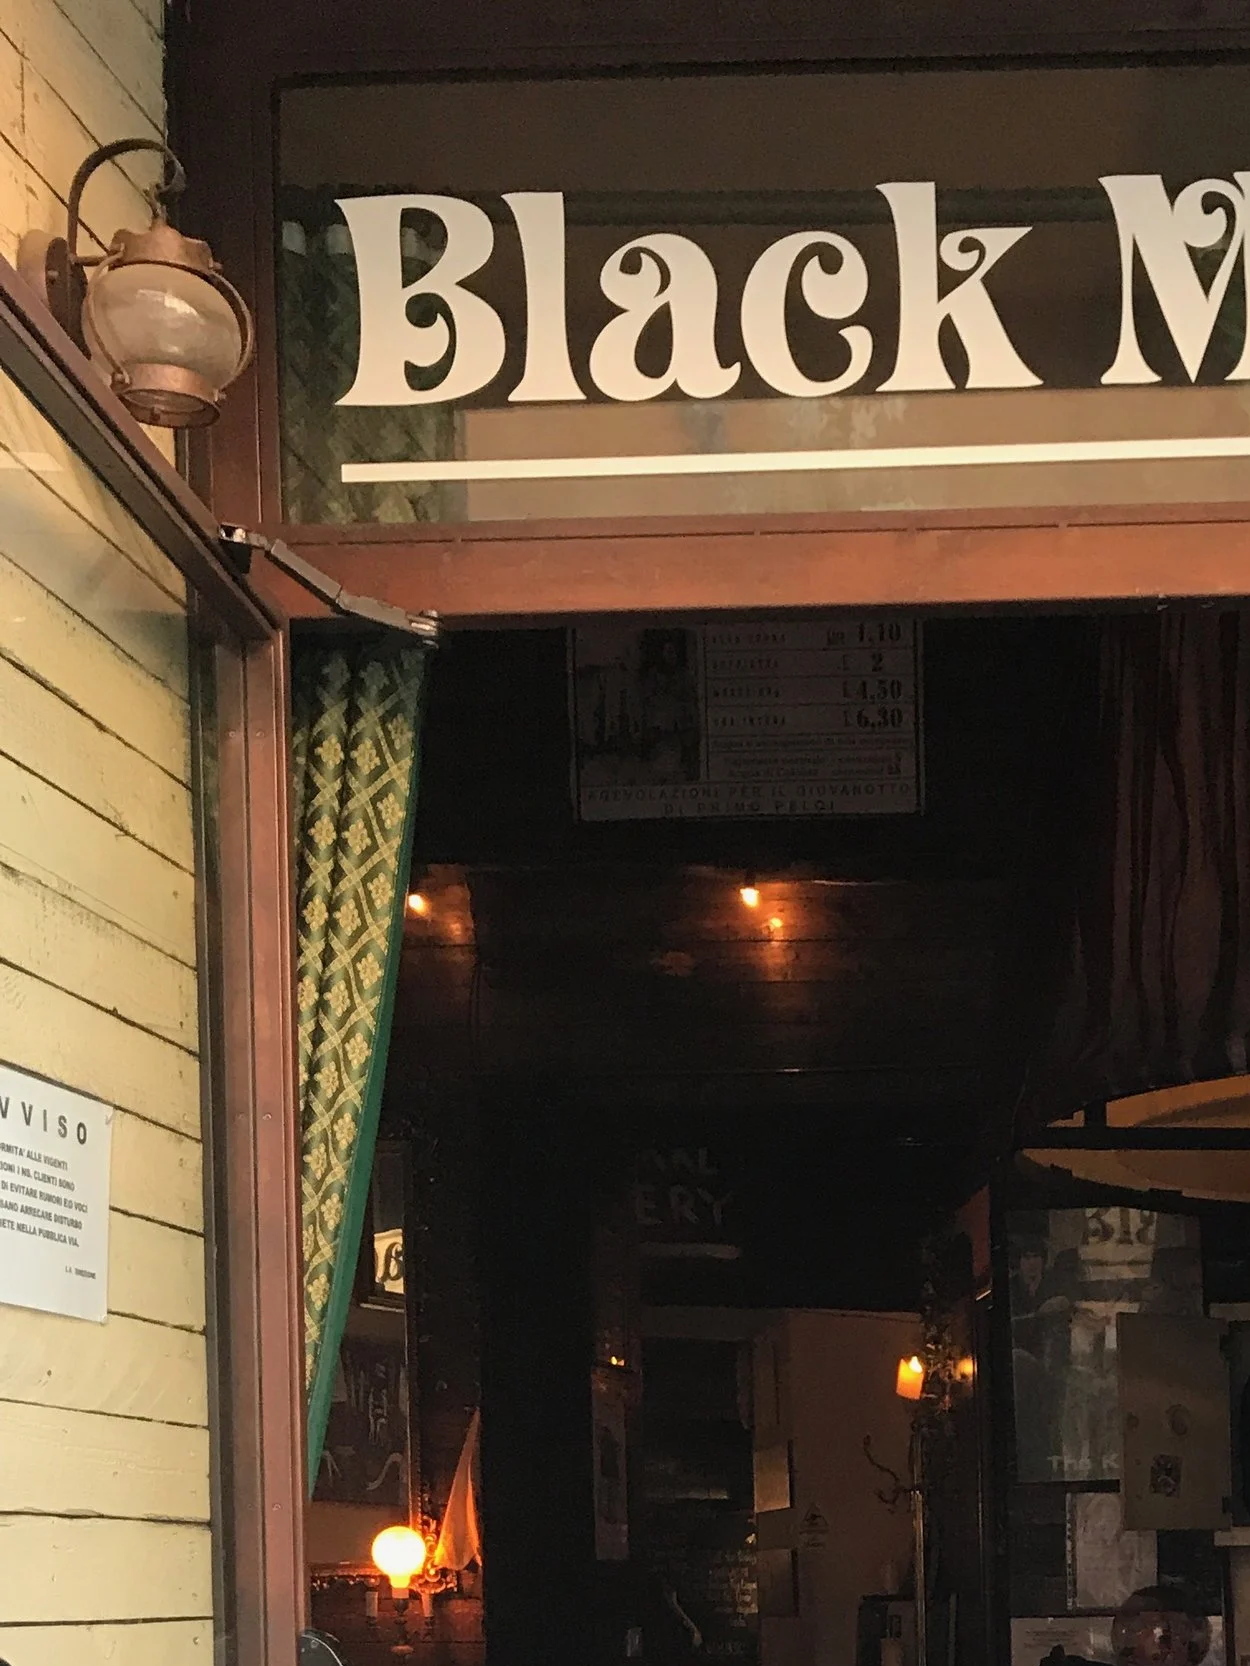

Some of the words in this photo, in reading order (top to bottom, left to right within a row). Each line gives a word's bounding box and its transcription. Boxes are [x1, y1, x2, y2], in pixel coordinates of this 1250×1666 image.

[335, 181, 1044, 406] Black
[728, 783, 766, 799] PER
[697, 801, 760, 815] PRIMO
[26, 1149, 42, 1163] ALLE
[43, 1155, 68, 1171] VIGENTI
[33, 1170, 57, 1186] CLIENTI
[10, 1182, 37, 1199] EVITARE
[20, 1204, 52, 1221] ARRECARE
[16, 1222, 37, 1235] NELLA
[38, 1227, 67, 1243] PUBBLICA
